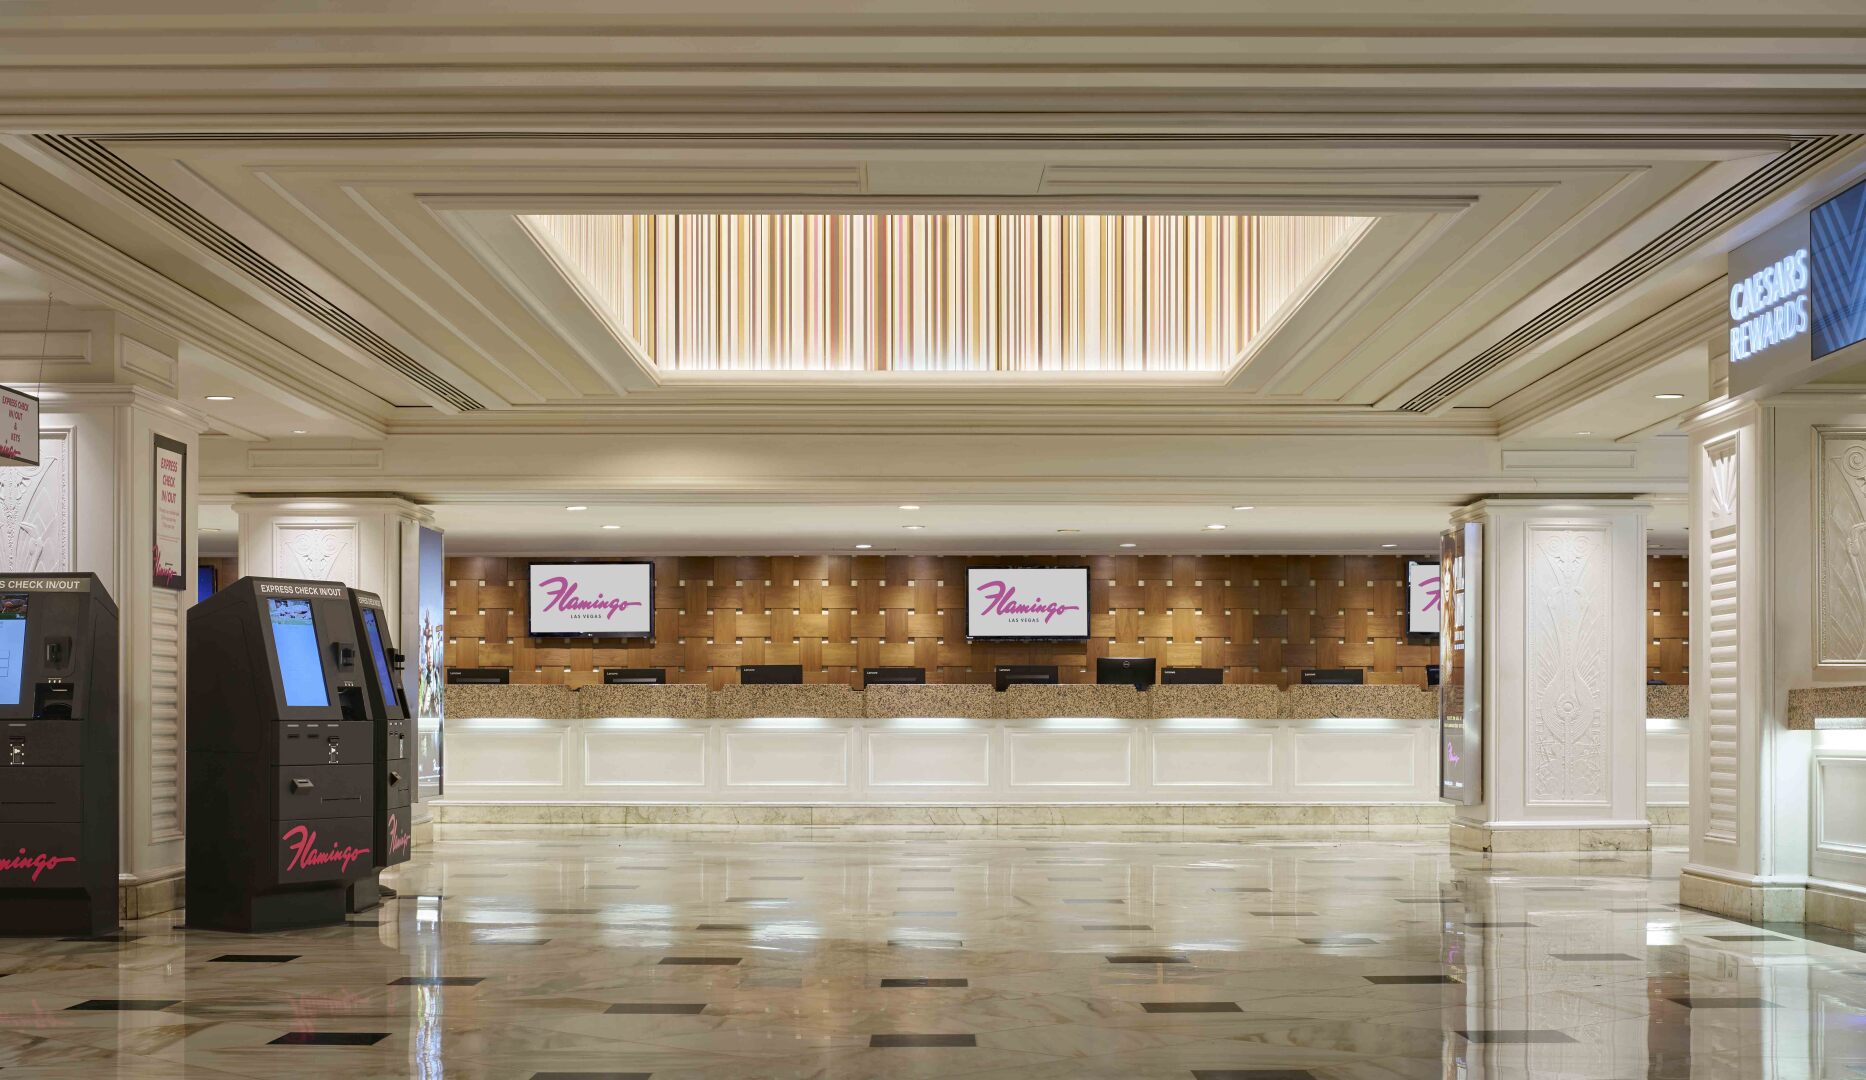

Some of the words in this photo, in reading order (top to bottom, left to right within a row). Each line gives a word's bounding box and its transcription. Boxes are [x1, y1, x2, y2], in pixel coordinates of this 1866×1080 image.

[1729, 249, 1809, 321] CAESARS
[1729, 296, 1808, 362] REWARDS
[160, 457, 178, 473] EXPRESS
[7, 580, 44, 589] CHECK
[45, 580, 81, 590] IN/OUT
[260, 584, 294, 594] EXPRESS
[294, 586, 318, 596] CHECK
[319, 588, 342, 597] IN/OUT
[538, 576, 642, 620] Flamingo
[976, 580, 1080, 625] Flamingo
[0, 847, 76, 882] mingo
[282, 825, 370, 873] Flamingo
